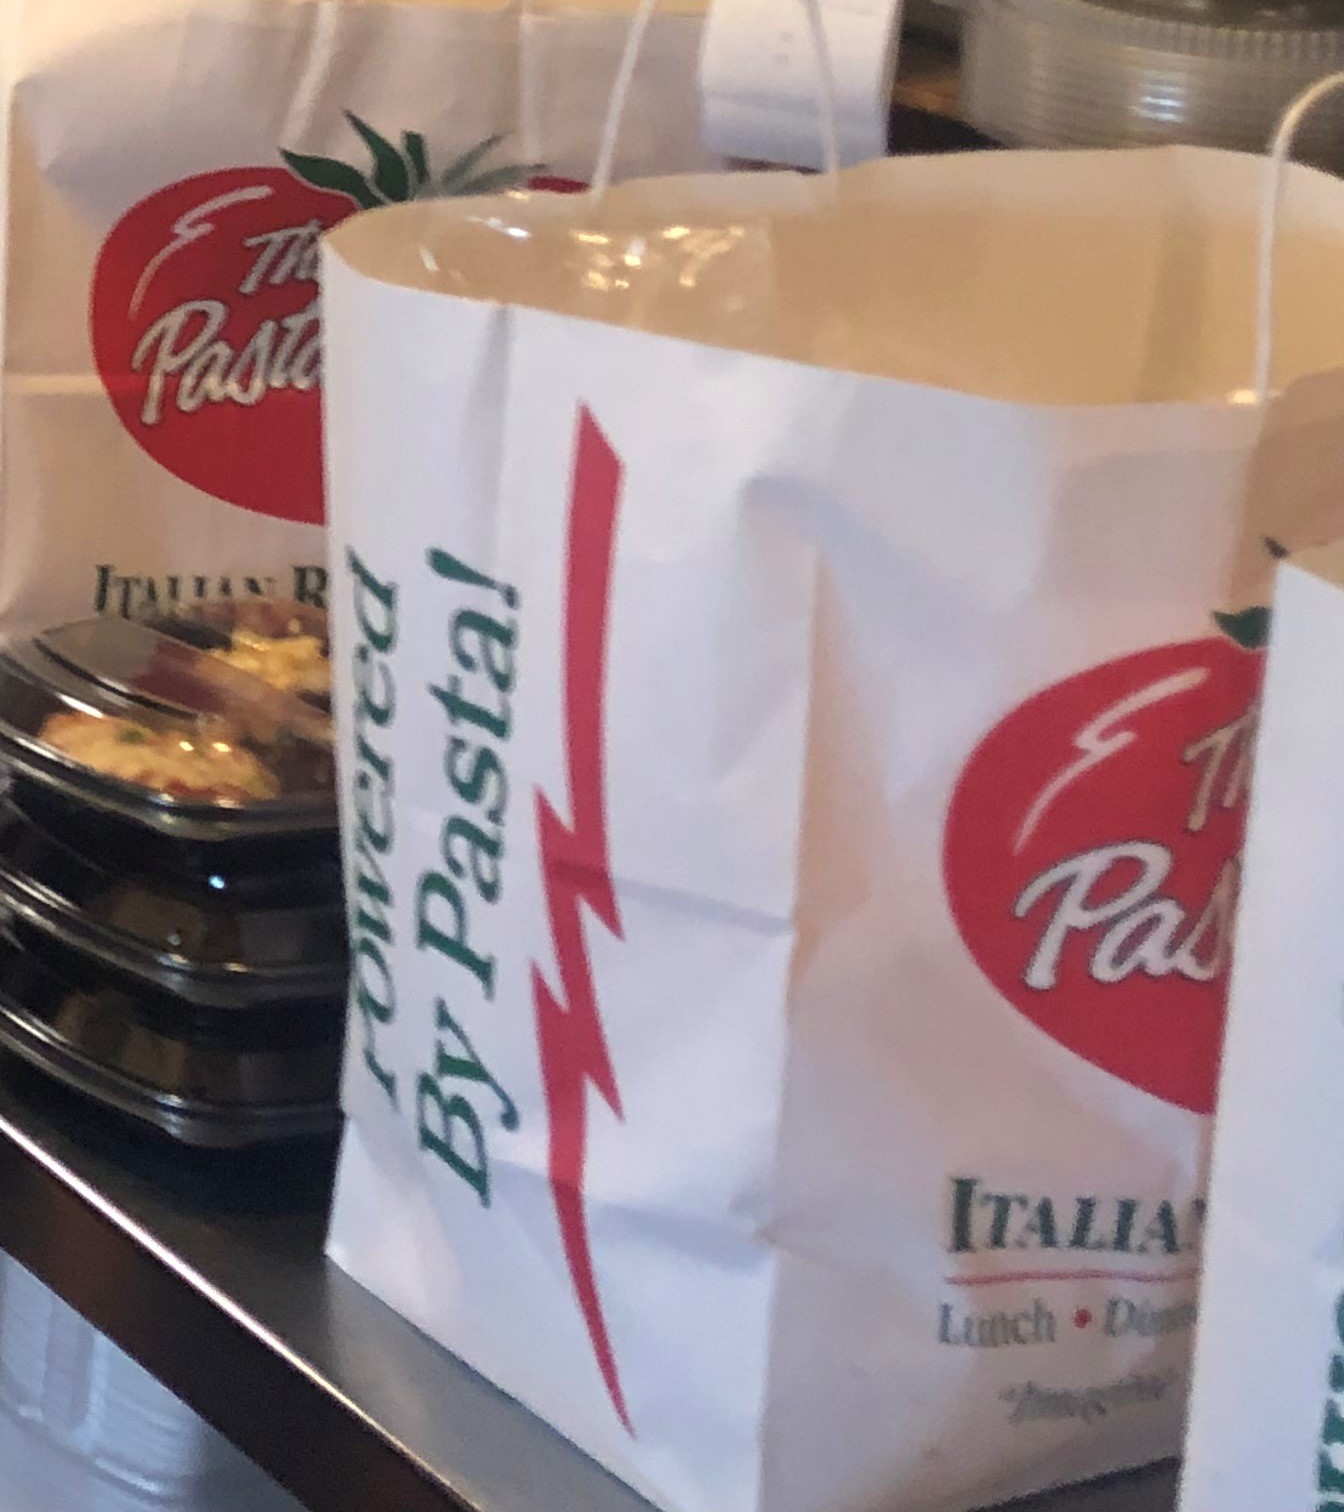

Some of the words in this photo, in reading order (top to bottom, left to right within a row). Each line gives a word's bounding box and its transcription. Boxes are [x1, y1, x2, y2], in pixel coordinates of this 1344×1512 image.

[414, 545, 523, 1002] Pasta!
[416, 996, 521, 1210] By
[937, 1294, 1057, 1347] Lunch
